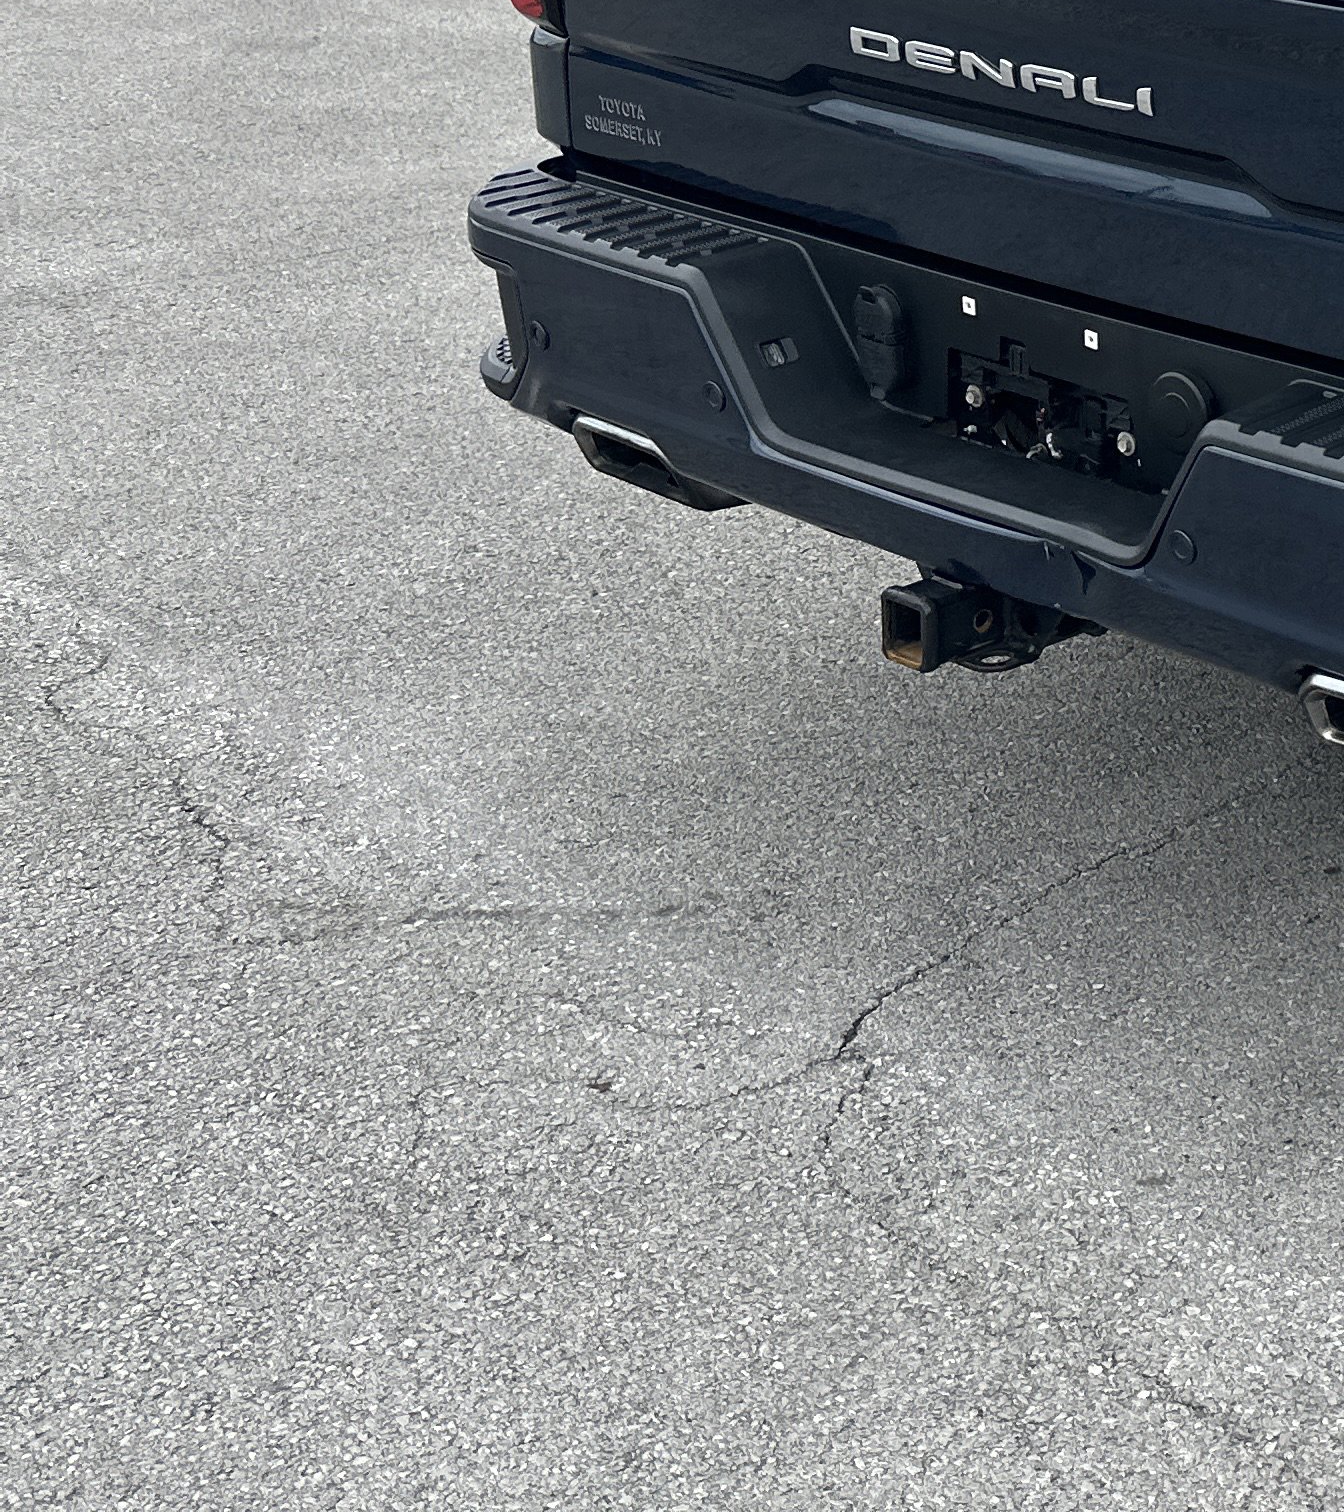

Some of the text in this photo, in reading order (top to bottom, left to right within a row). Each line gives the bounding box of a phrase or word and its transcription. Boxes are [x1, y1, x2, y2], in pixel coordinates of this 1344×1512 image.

[850, 26, 1154, 117] DENALI
[598, 95, 647, 122] TOYOTA
[647, 128, 662, 148] KY
